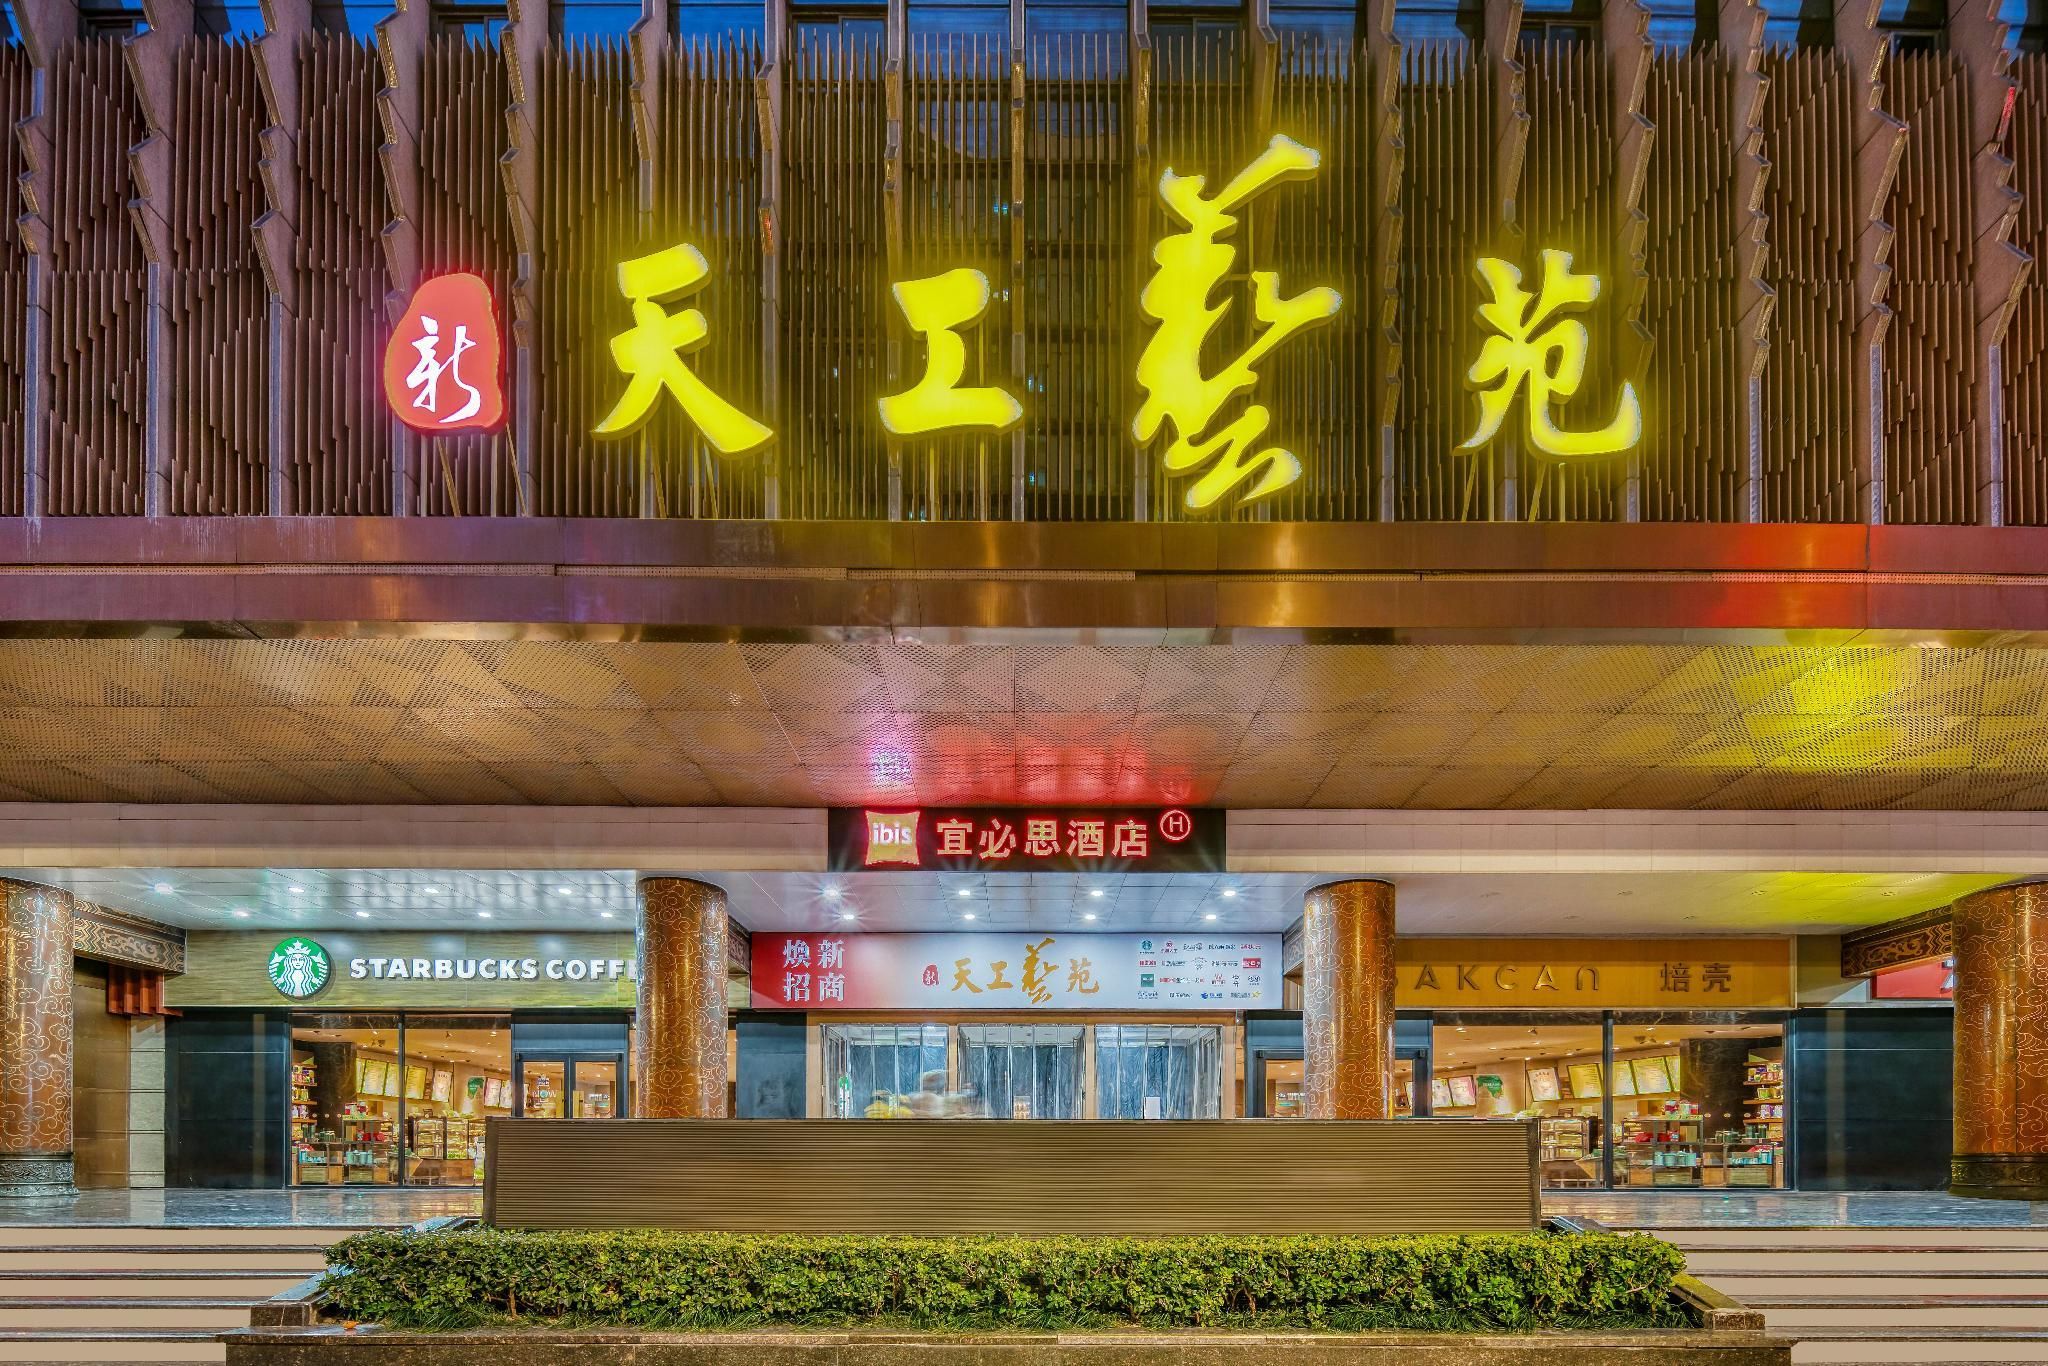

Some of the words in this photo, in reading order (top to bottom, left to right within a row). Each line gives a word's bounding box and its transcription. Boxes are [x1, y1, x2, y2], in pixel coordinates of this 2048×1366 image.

[405, 314, 481, 424] 新
[872, 822, 913, 845] ibis
[936, 818, 1147, 858] 宜必思酒店
[350, 958, 539, 980] STARBUCKS
[1660, 962, 1733, 993] 焙壳
[783, 971, 845, 1002] 招商
